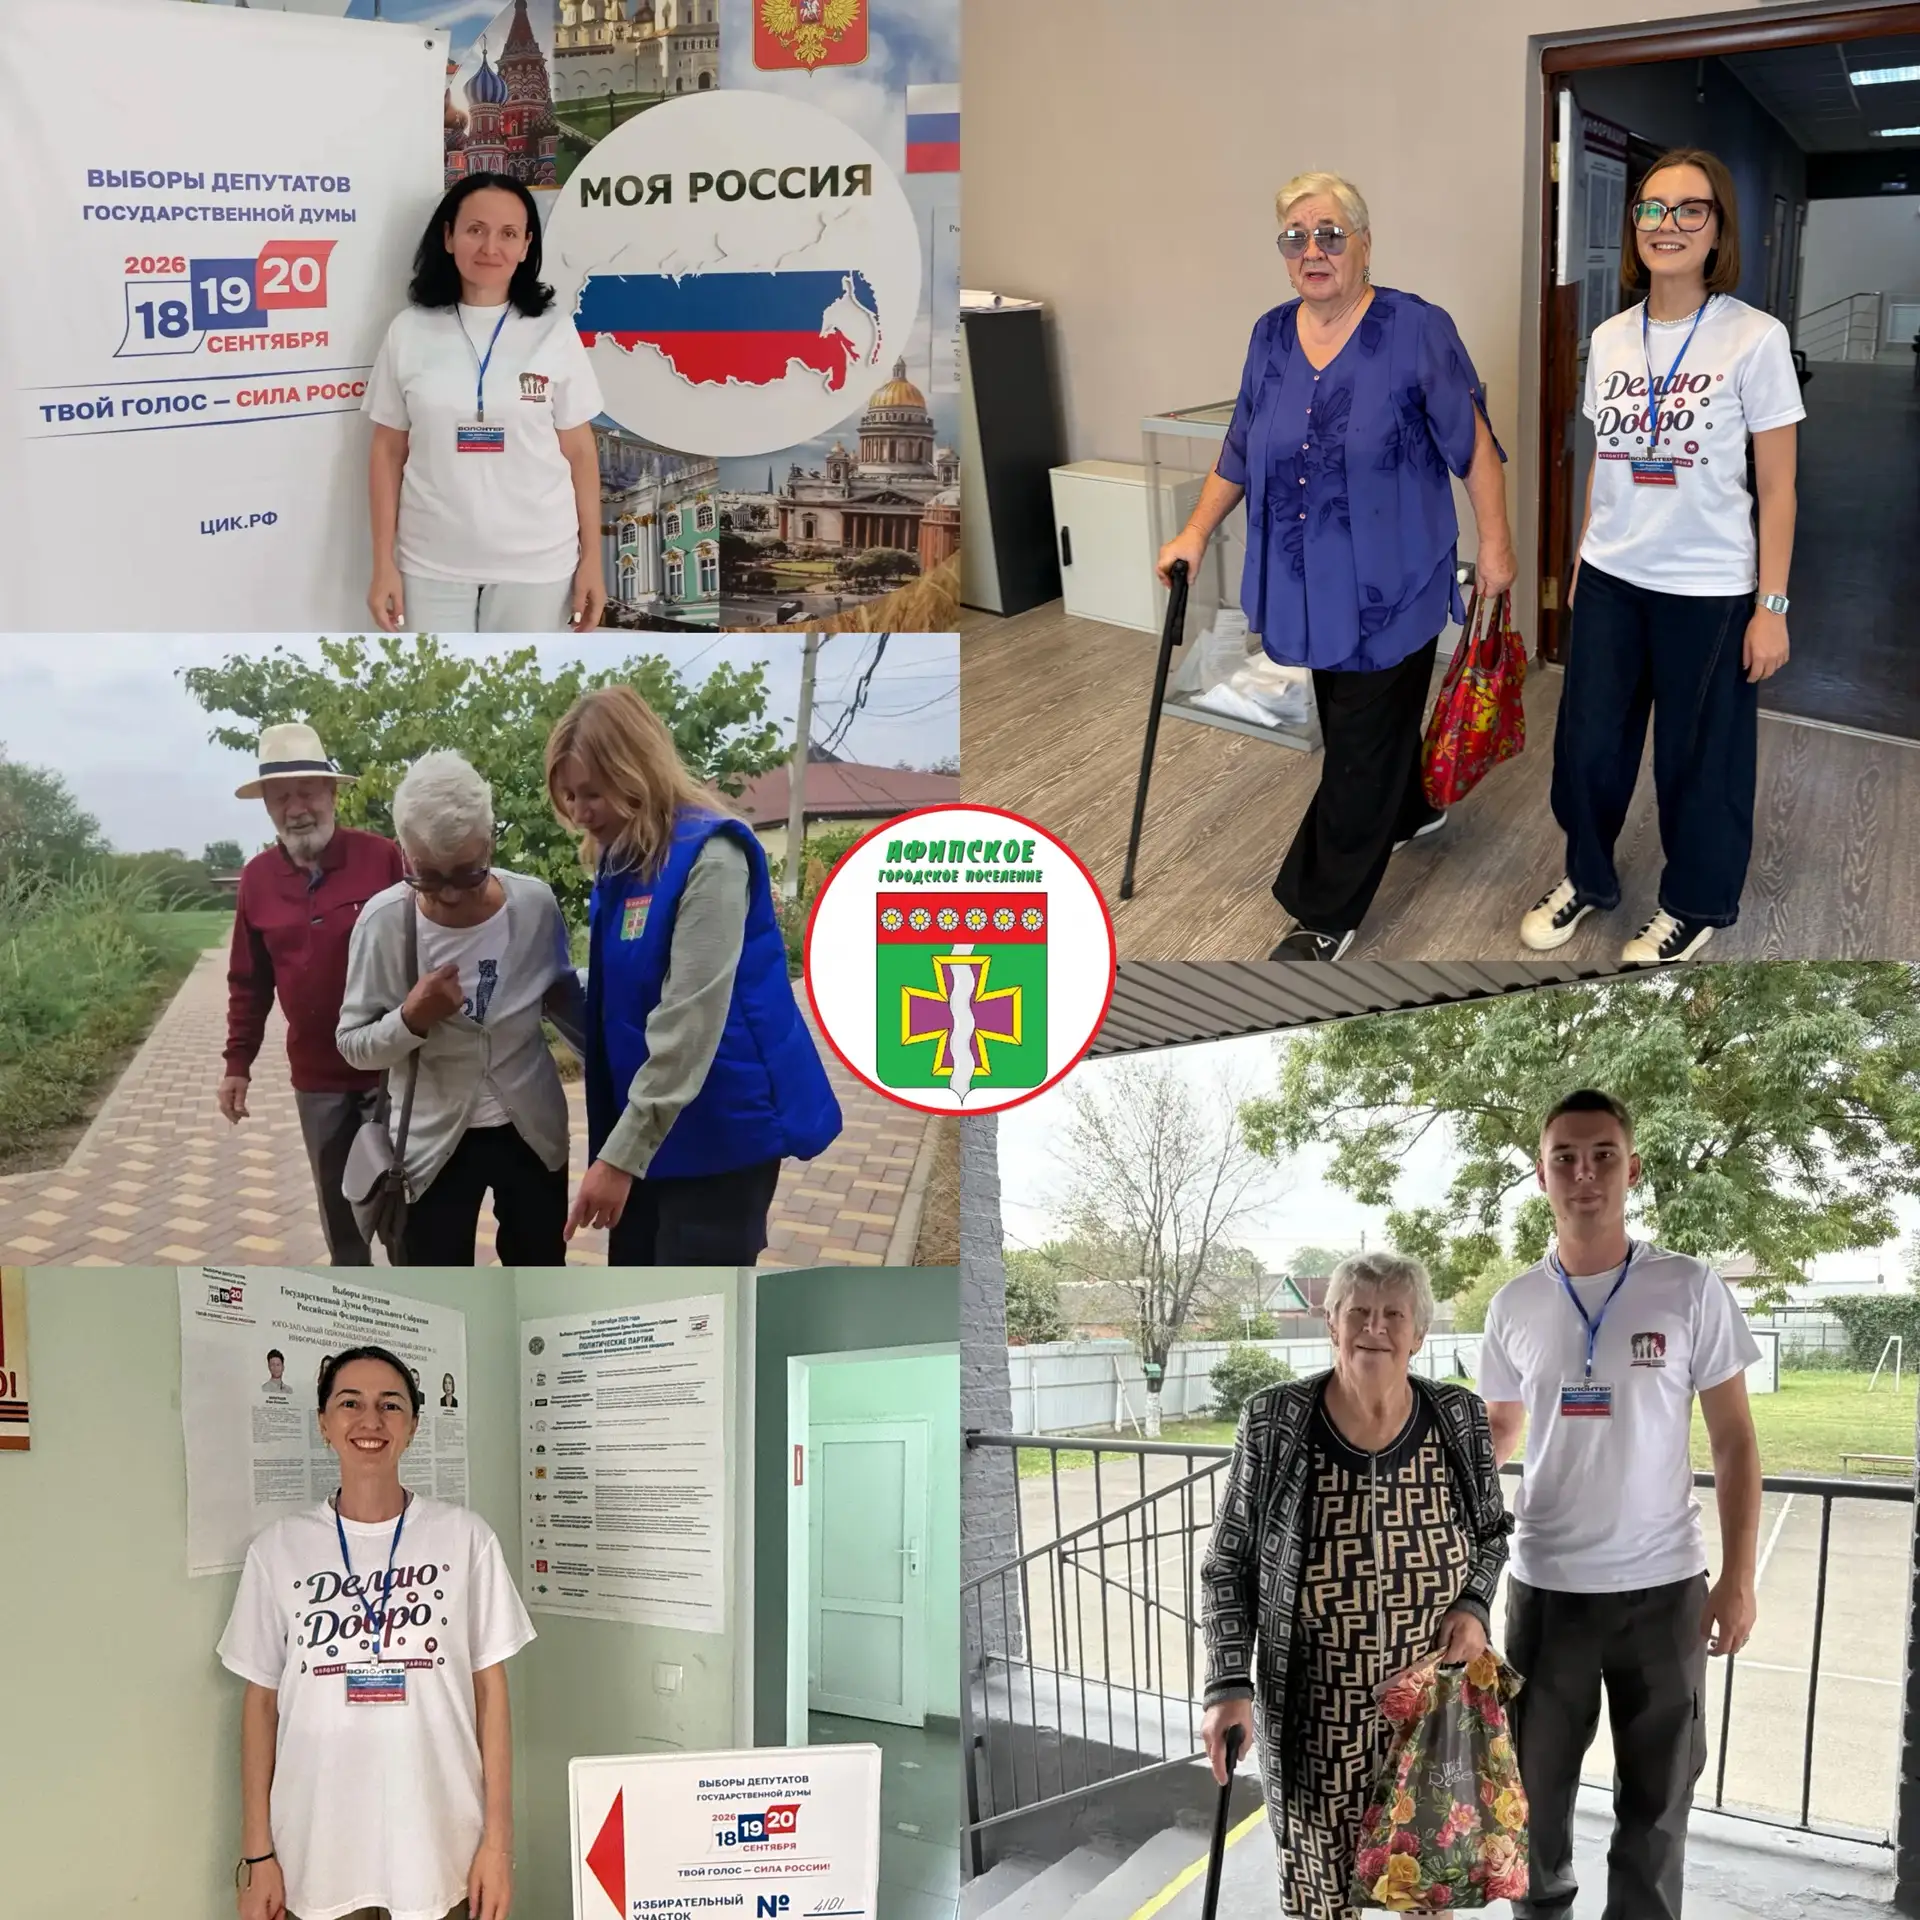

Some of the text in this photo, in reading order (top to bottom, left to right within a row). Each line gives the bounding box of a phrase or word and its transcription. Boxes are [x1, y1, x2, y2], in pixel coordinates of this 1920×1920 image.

[87, 169, 351, 193] ВЫБОРЫ ДЕПУТАТОВ
[580, 164, 872, 208] МОЯ РОССИЯ
[83, 205, 356, 225] ГОСУДАРСТВЕННОЙ ДУМЫ
[124, 256, 186, 274] 2026
[135, 256, 321, 339] 18 19 20
[206, 331, 329, 354] СЕНТЯБРЯ
[1603, 371, 1711, 400] Делаю
[40, 397, 114, 423] ТВОЙ
[121, 394, 207, 418] ГОЛОС
[236, 384, 300, 407] СИЛА
[307, 381, 368, 401] РОСС
[200, 511, 278, 535] ЦИК.РФ
[231, 1289, 241, 1299] 20
[307, 1564, 438, 1604] Делаю
[699, 1775, 809, 1788] ВЫБОРЫ ДЕПУТАТОВ
[697, 1789, 811, 1801] ГОСУДАРСТВЕННОЙ ДУМЫ
[712, 1813, 736, 1821] 2026
[715, 1811, 794, 1846] 18 19 20
[743, 1843, 797, 1852] СЕНТЯБРЯ
[678, 1867, 705, 1877] ТВОЙ
[708, 1867, 742, 1875] ГОЛОС
[754, 1865, 782, 1873] СИЛА
[785, 1863, 831, 1872] РОССИИ!
[633, 1894, 744, 1910] ИЗБИРАТЕЛЬНЫЙ
